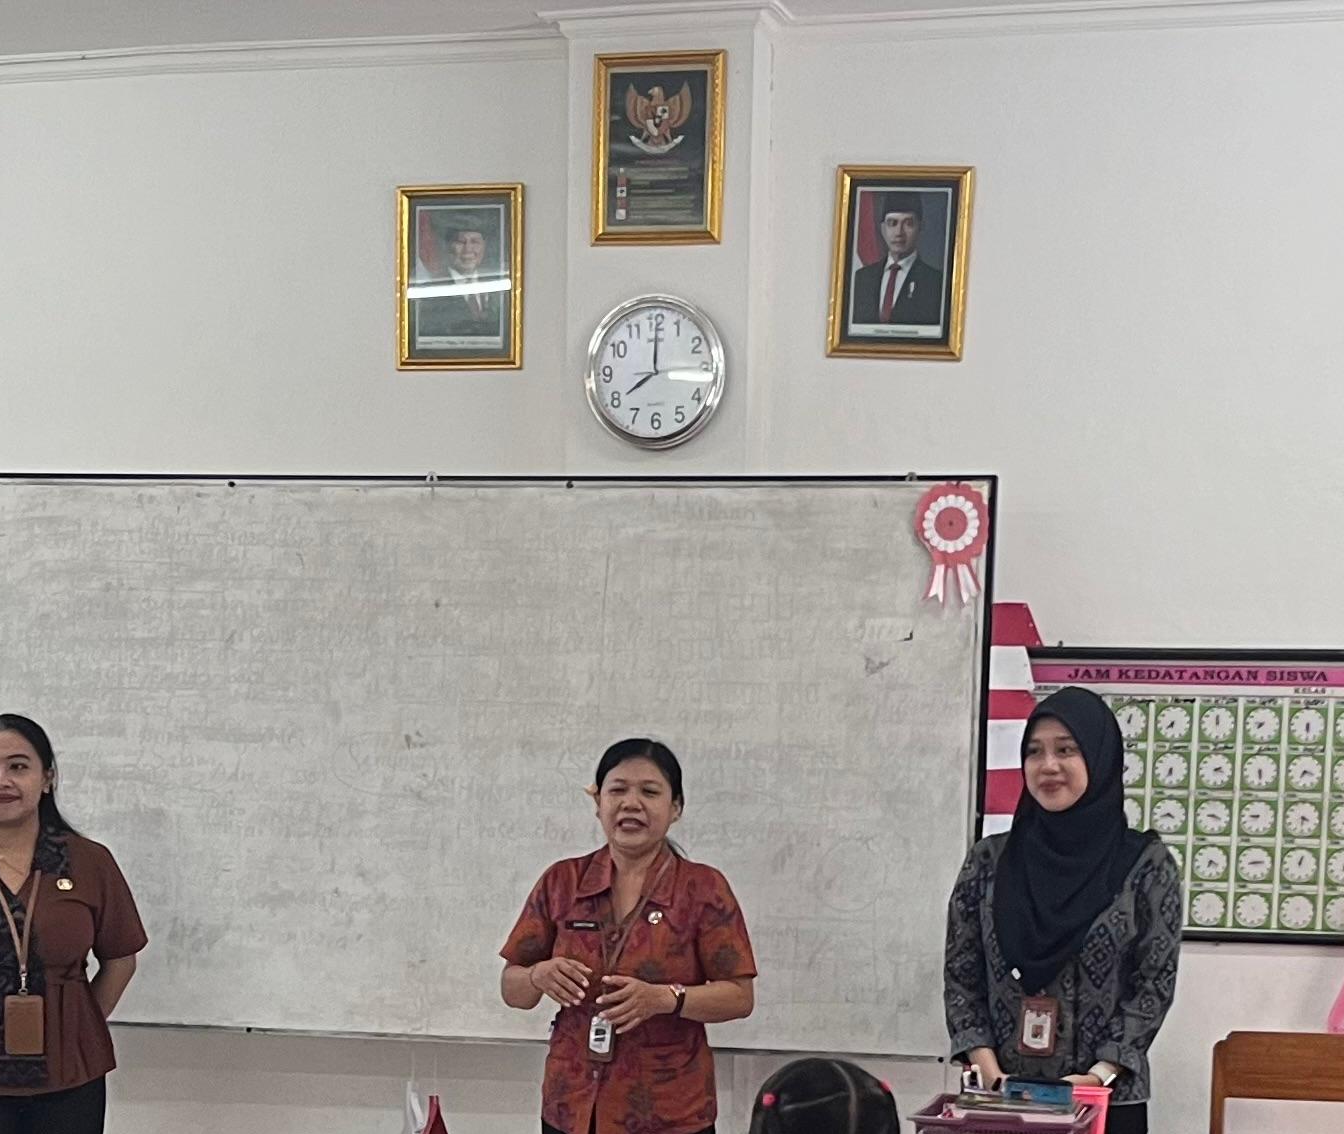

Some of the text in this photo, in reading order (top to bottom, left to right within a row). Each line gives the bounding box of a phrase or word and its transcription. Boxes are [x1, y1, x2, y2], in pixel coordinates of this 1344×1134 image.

[626, 323, 640, 339] 11
[648, 313, 664, 332] 12
[674, 320, 681, 337] 1
[610, 341, 627, 358] 10
[691, 336, 702, 354] 2
[602, 365, 613, 383] 9
[610, 391, 621, 408] 8
[691, 387, 701, 404] 4
[629, 407, 640, 424] 7
[650, 412, 662, 430] 6
[674, 406, 685, 423] 5
[1068, 668, 1328, 682] JAM KEDATANGAN SISWA
